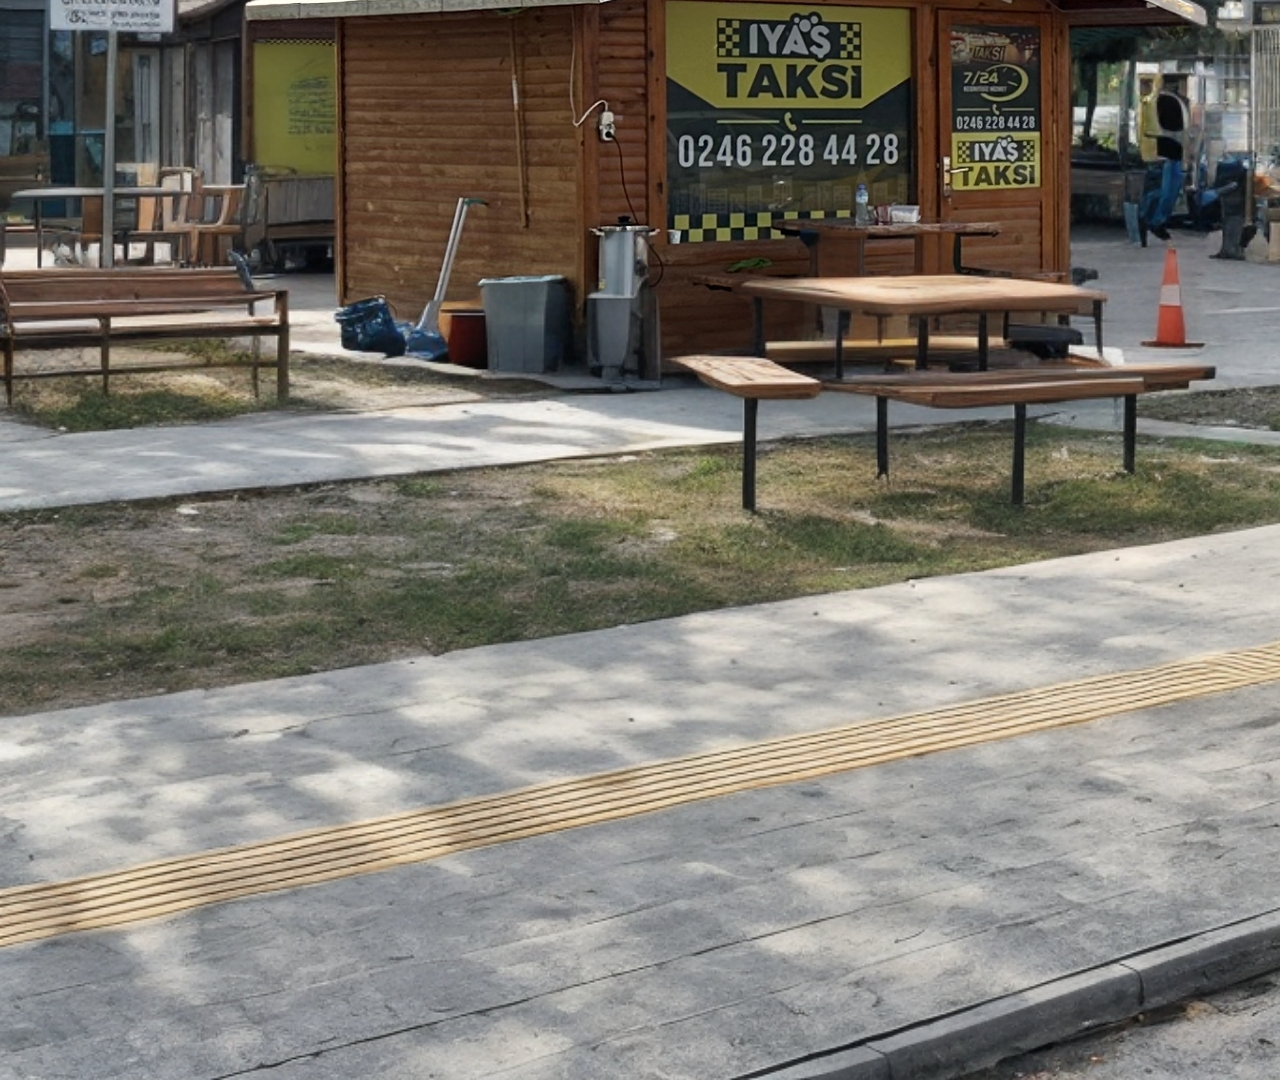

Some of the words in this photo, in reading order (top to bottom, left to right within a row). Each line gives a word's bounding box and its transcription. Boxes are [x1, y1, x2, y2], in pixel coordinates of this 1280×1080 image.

[963, 70, 999, 85] 7/24
[956, 115, 983, 129] 0246
[985, 115, 1005, 129] 228
[1007, 115, 1020, 129] 44
[1022, 115, 1035, 129] 28
[678, 134, 752, 168] 0246
[762, 134, 814, 166] 228
[823, 134, 857, 165] 44
[866, 133, 899, 165] 28
